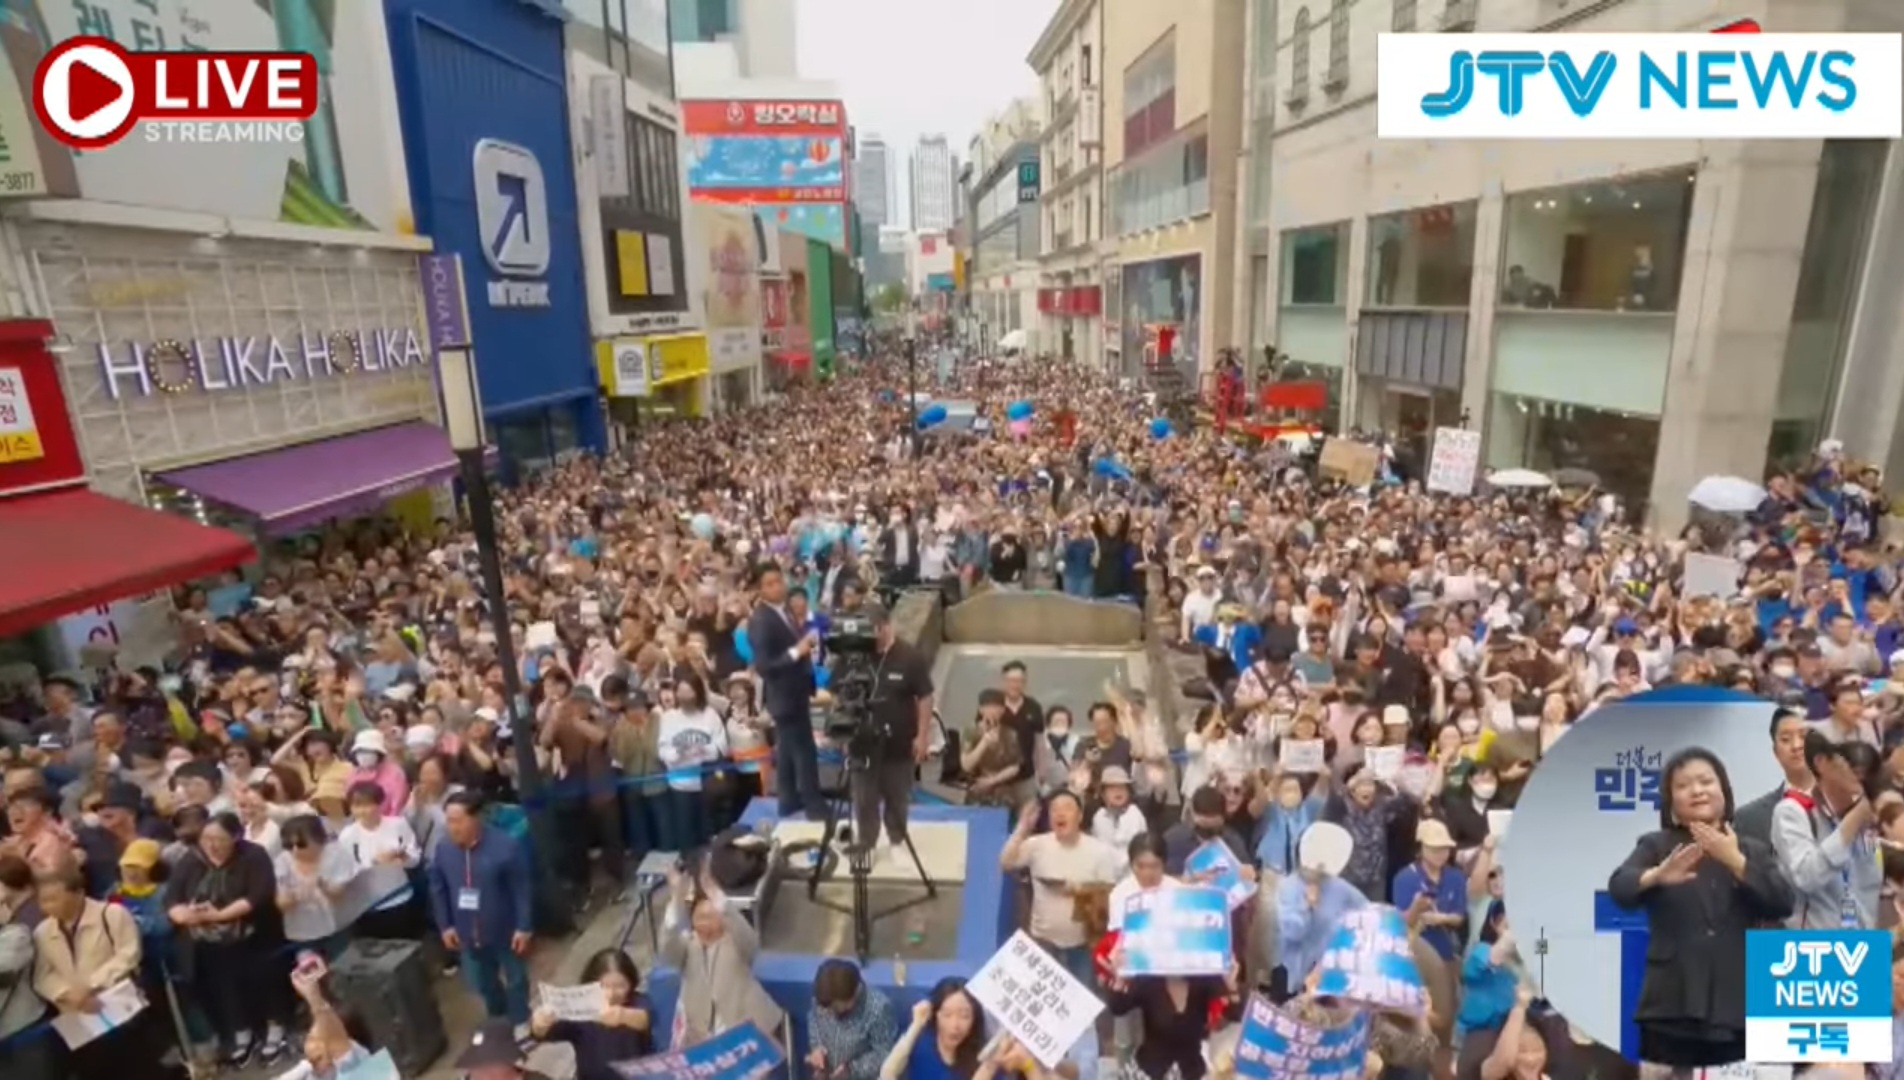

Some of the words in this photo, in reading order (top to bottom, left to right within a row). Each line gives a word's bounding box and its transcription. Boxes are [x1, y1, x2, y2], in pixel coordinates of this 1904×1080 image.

[100, 335, 295, 400] HOLIKA
[302, 328, 425, 378] HOLIKA
[1615, 745, 1662, 770] 더불어
